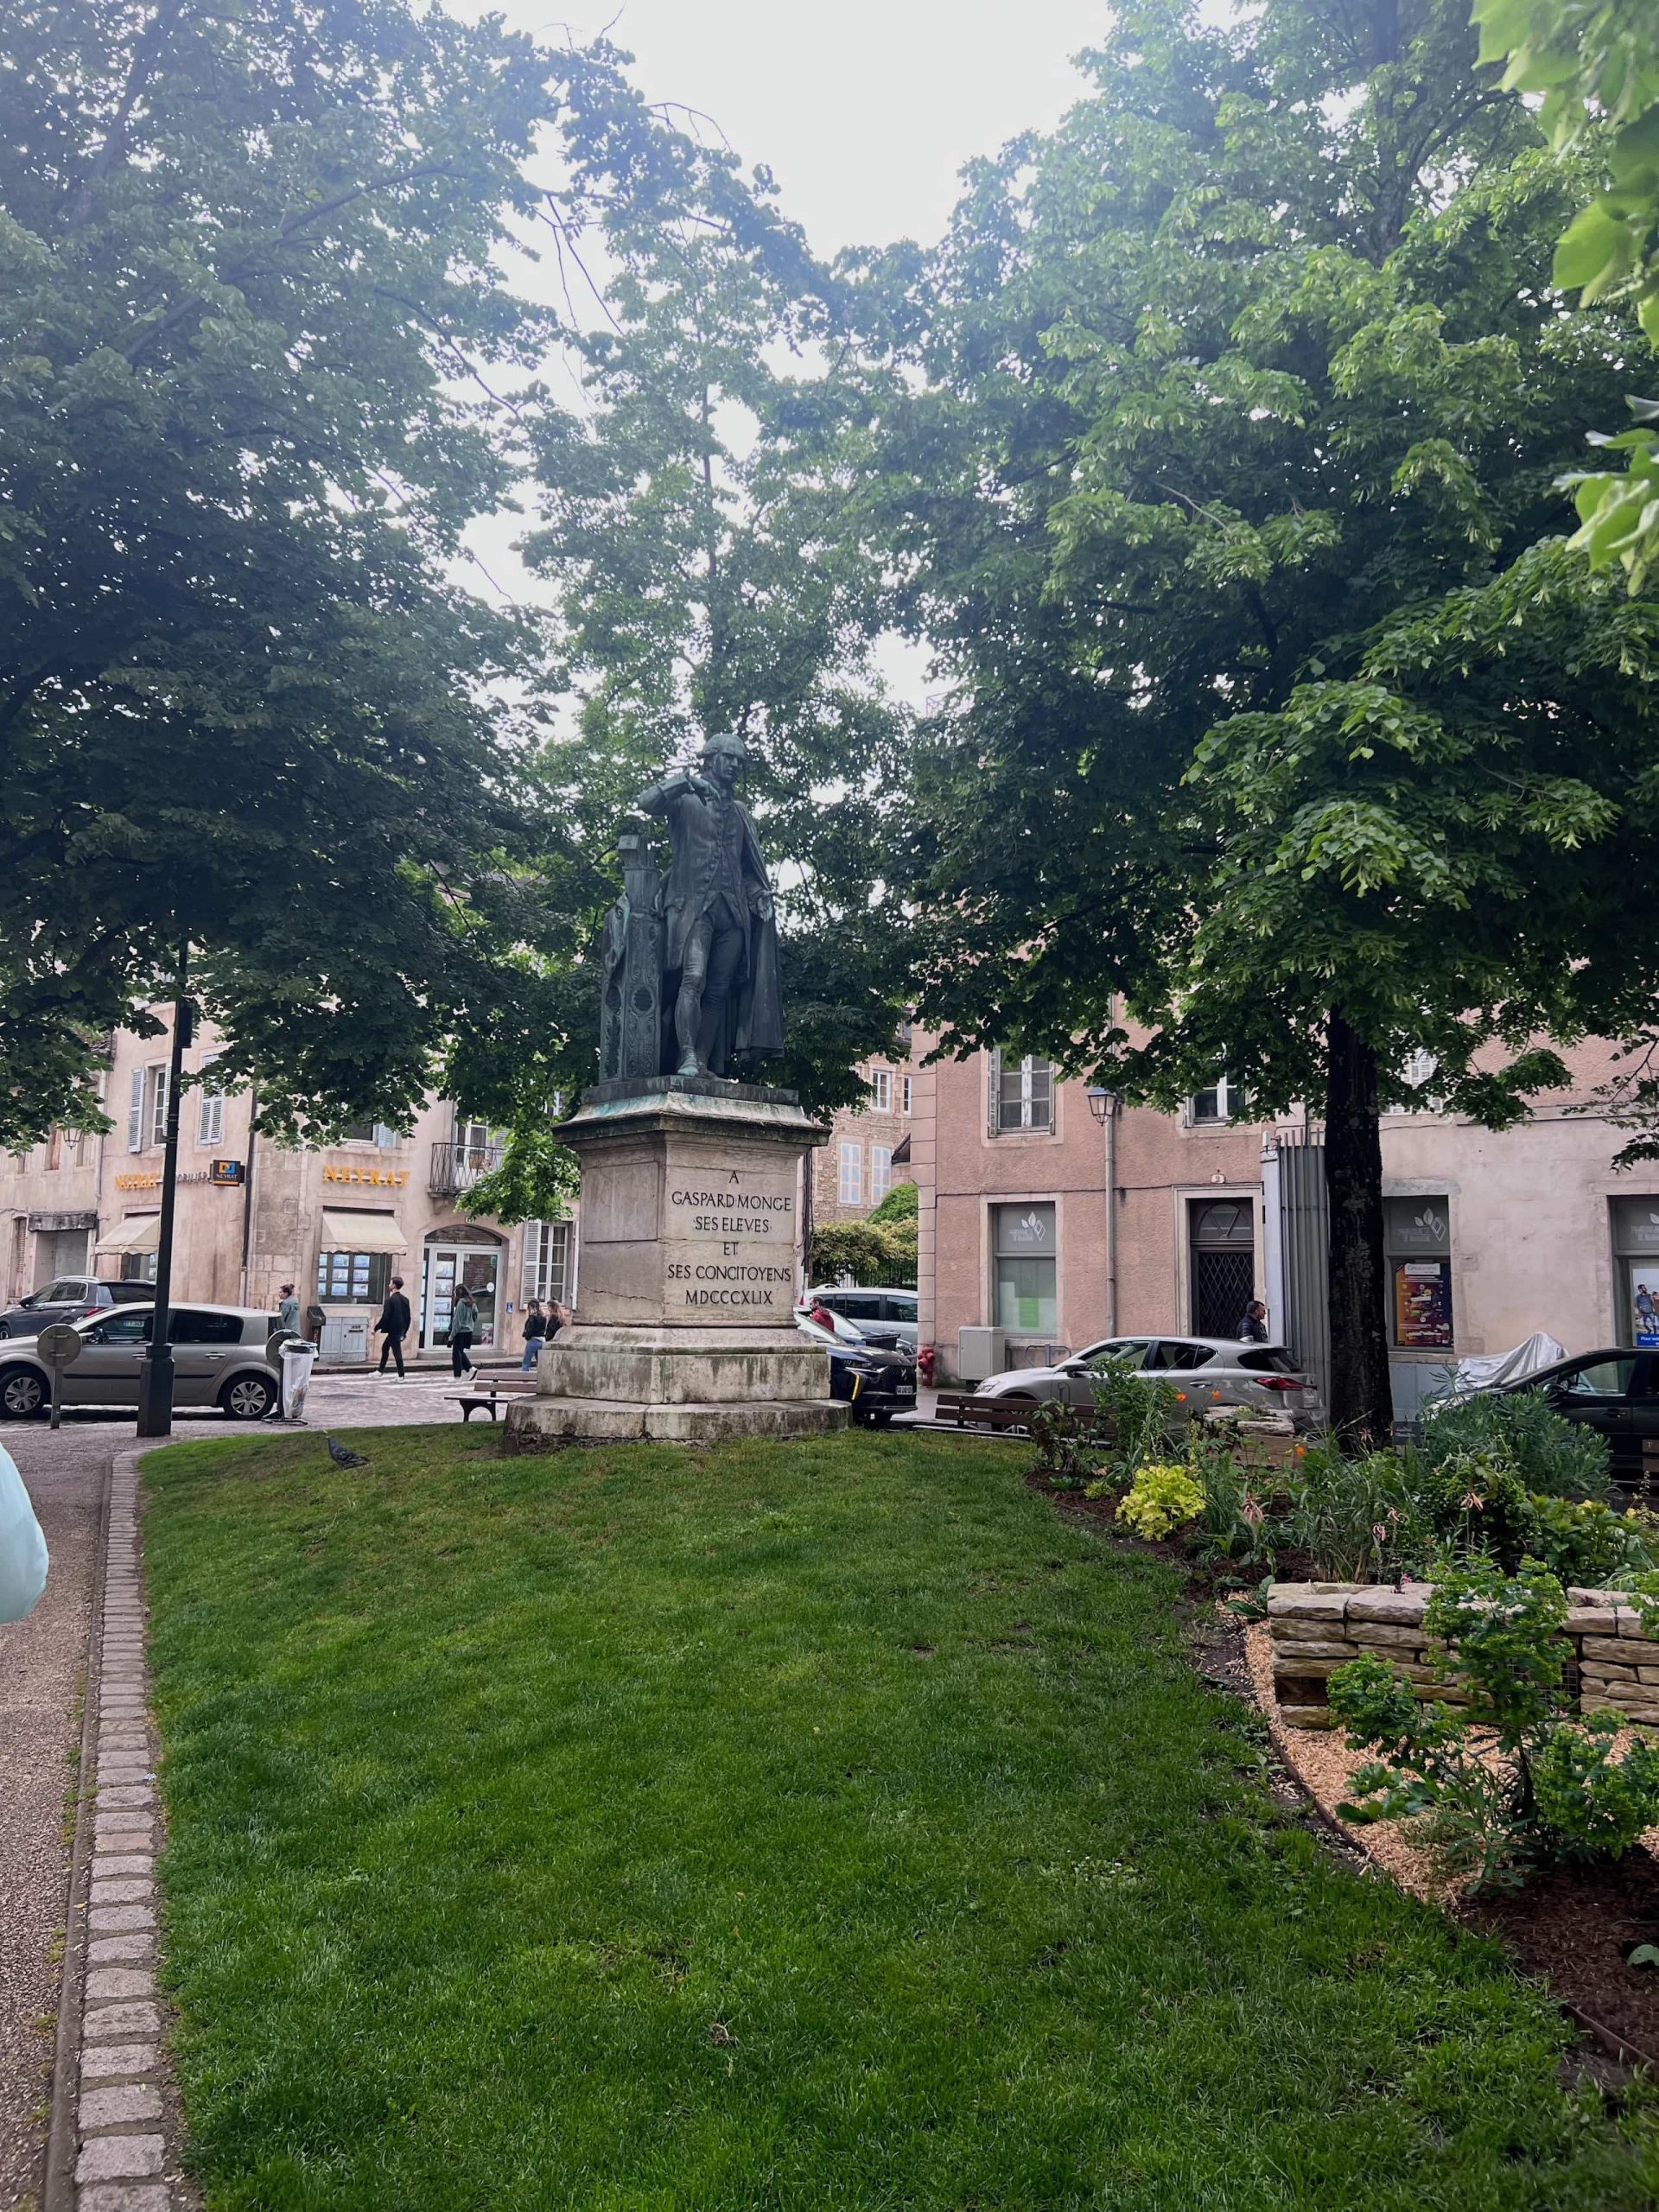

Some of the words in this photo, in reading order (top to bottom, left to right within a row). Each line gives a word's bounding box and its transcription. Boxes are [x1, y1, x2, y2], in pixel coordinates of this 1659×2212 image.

[322, 1165, 410, 1189] NEYRAT
[728, 1171, 740, 1184] A
[671, 1191, 734, 1208] GASPARD
[737, 1195, 792, 1211] MONGE
[695, 1217, 719, 1231] SES
[722, 1217, 770, 1233] ELEVES
[723, 1242, 739, 1255] ET
[667, 1264, 691, 1279] SES
[696, 1265, 791, 1281] CONCITOYENS
[685, 1290, 773, 1305] MDCCCXLIX
